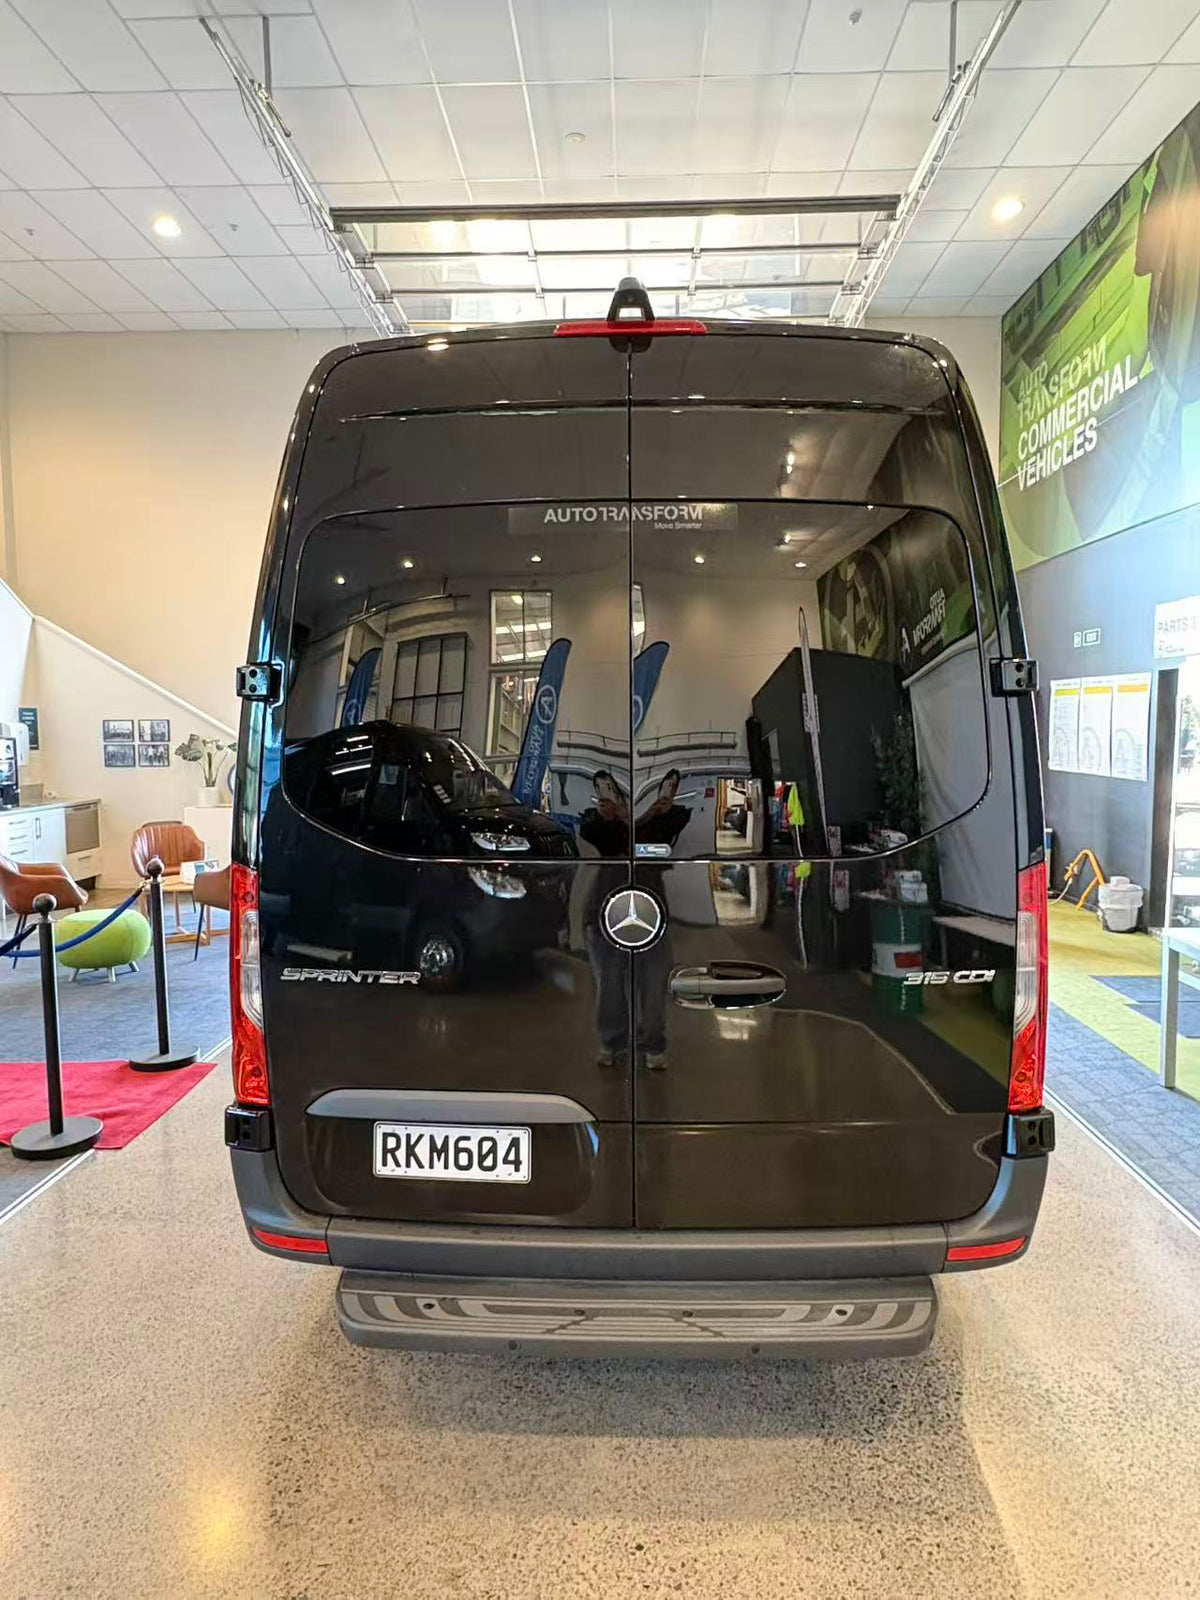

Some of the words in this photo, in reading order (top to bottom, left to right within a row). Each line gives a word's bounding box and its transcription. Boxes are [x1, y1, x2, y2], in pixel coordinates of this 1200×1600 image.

[1017, 337, 1106, 428] TRANSFORM
[1018, 361, 1048, 401] AUTO
[1018, 354, 1138, 461] COMMERCIAL
[1017, 417, 1098, 491] VEHICLES
[654, 521, 674, 529] Move
[1158, 616, 1189, 634] PARTS
[280, 967, 421, 985] SPRINTER
[903, 971, 950, 985] 315
[953, 969, 995, 984] CDI
[381, 1132, 523, 1173] RKM604
